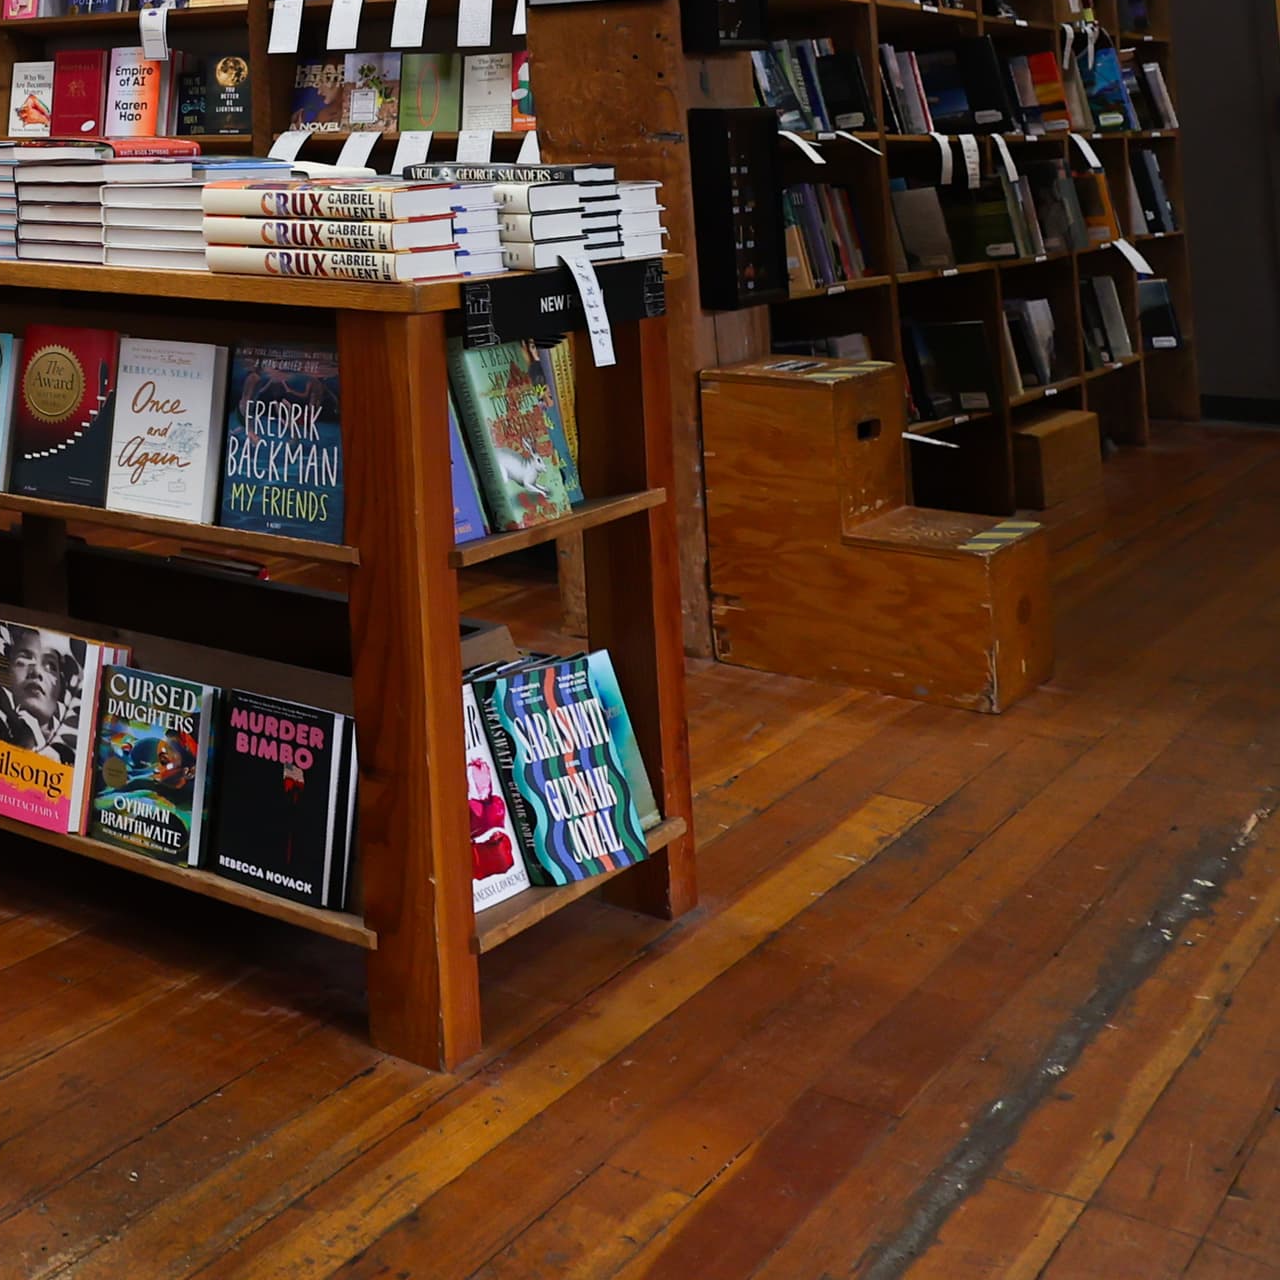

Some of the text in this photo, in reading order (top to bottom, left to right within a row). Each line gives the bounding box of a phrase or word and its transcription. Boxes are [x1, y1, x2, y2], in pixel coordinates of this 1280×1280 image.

[115, 65, 153, 77] Empire
[119, 77, 146, 87] of AI
[114, 100, 148, 111] Karen
[119, 112, 142, 122] Hao
[410, 166, 551, 182] VIGIL GEORGE SAUNDERS
[260, 191, 324, 218] CRUX
[326, 206, 375, 219] TALLENT
[327, 192, 374, 206] GABRIEL
[260, 221, 326, 249] CRUX
[327, 223, 374, 237] GABRIEL
[327, 237, 377, 250] TALLENT
[264, 251, 327, 277] CRUX
[331, 254, 378, 267] GABRIEL
[331, 267, 379, 280] TALLENT
[132, 381, 187, 414] Once
[147, 421, 170, 438] and
[245, 400, 323, 441] FREDRIK
[117, 436, 191, 485] Again
[227, 436, 338, 488] BACKMAN
[231, 483, 328, 522] MY FRIENDS
[110, 674, 197, 714] CURSED
[108, 698, 194, 734] DAUGHTERS
[230, 707, 325, 750] MURDER
[514, 697, 609, 764] SARASWATI
[236, 732, 314, 770] BIMBO
[545, 765, 617, 822] GURNAIK
[113, 796, 170, 824] OYINKAN
[100, 810, 182, 848] BRAITHWAITE
[567, 811, 623, 863] JOHAL
[219, 854, 312, 894] REBECCA NOVACK
